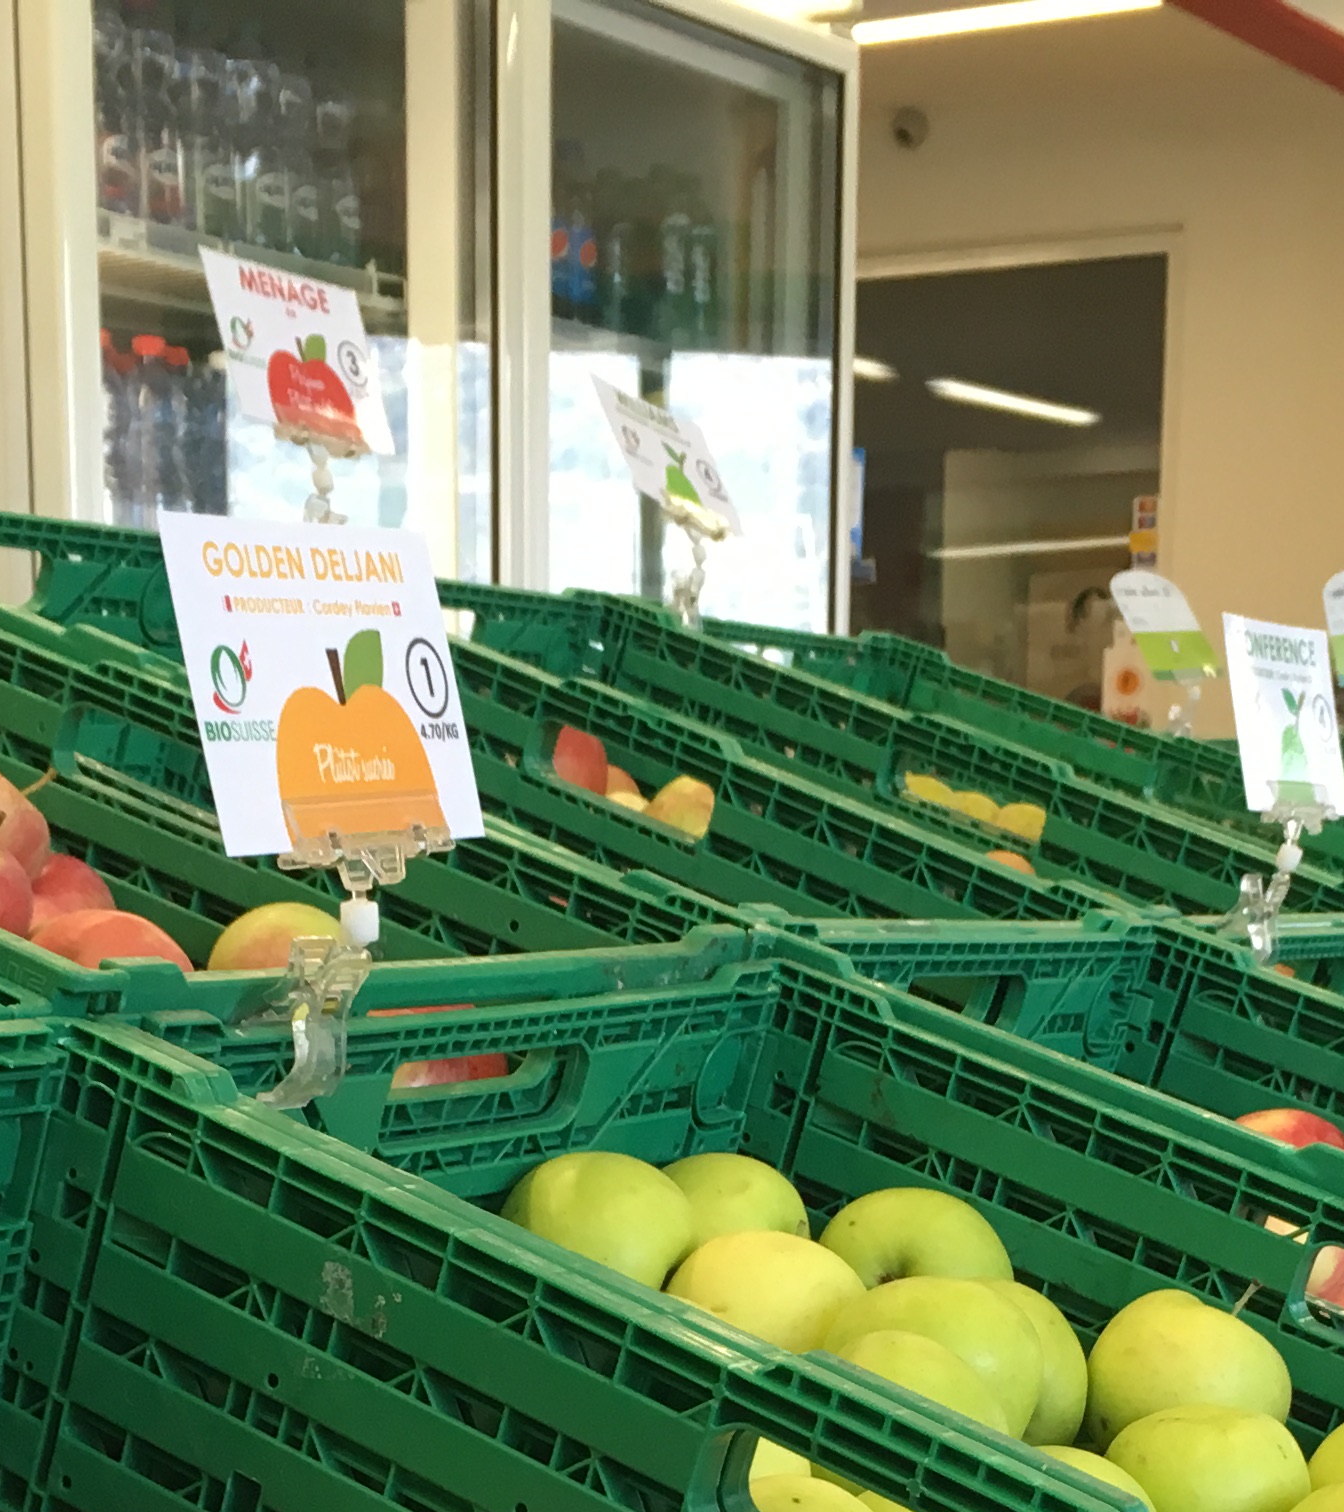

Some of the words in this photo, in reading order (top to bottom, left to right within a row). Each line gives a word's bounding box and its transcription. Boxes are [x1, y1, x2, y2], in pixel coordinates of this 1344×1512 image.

[239, 264, 330, 314] MENAGE
[346, 350, 360, 376] 3
[202, 541, 306, 579] GOLDEN
[310, 547, 404, 583] DELJANI
[233, 597, 305, 614] PRODUCTEUR
[1242, 629, 1317, 667] ONFERENCE
[420, 657, 434, 697] 1
[420, 723, 459, 741] 4.70/KG
